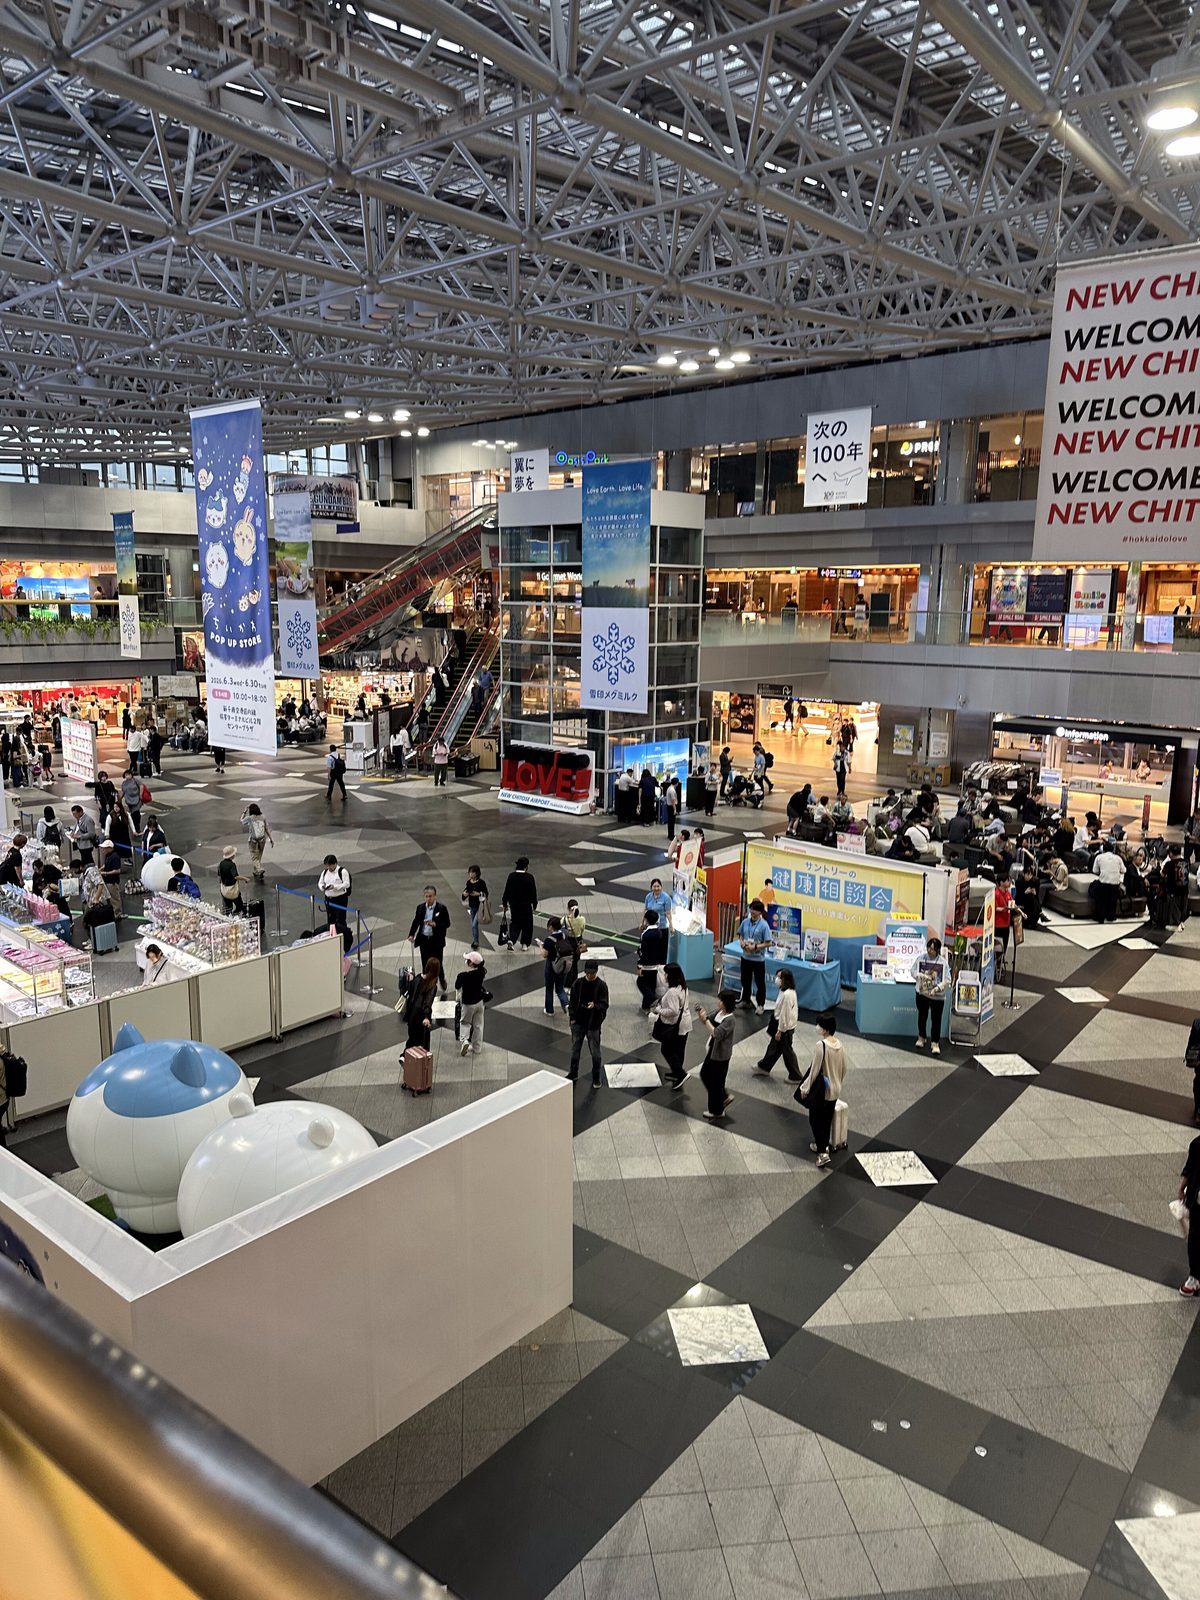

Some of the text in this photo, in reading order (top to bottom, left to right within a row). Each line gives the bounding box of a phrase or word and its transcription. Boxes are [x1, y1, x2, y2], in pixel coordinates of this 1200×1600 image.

[1065, 278, 1145, 312] NEW
[1059, 354, 1138, 384] NEW
[1057, 390, 1200, 424] WELCOM
[813, 420, 848, 440] 次の
[1053, 428, 1131, 456] NEW
[555, 450, 609, 466] Oasis Park
[812, 441, 864, 464] 100年
[514, 457, 535, 474] 翼に
[514, 475, 535, 492] 夢を
[586, 487, 599, 495] Love
[618, 484, 631, 492] Love
[1051, 465, 1200, 495] WELCOME
[1047, 498, 1200, 525] NEW CHIT
[1122, 534, 1188, 544] #hokkaidolove
[210, 631, 262, 649] POP UP STORE
[590, 689, 638, 702] 雪印メグミルク
[500, 791, 511, 799] NEW
[511, 793, 531, 803] CHITOSE
[530, 798, 550, 806] AIRPORT
[804, 861, 857, 879] サントリーの
[772, 870, 890, 911] 健康相談会
